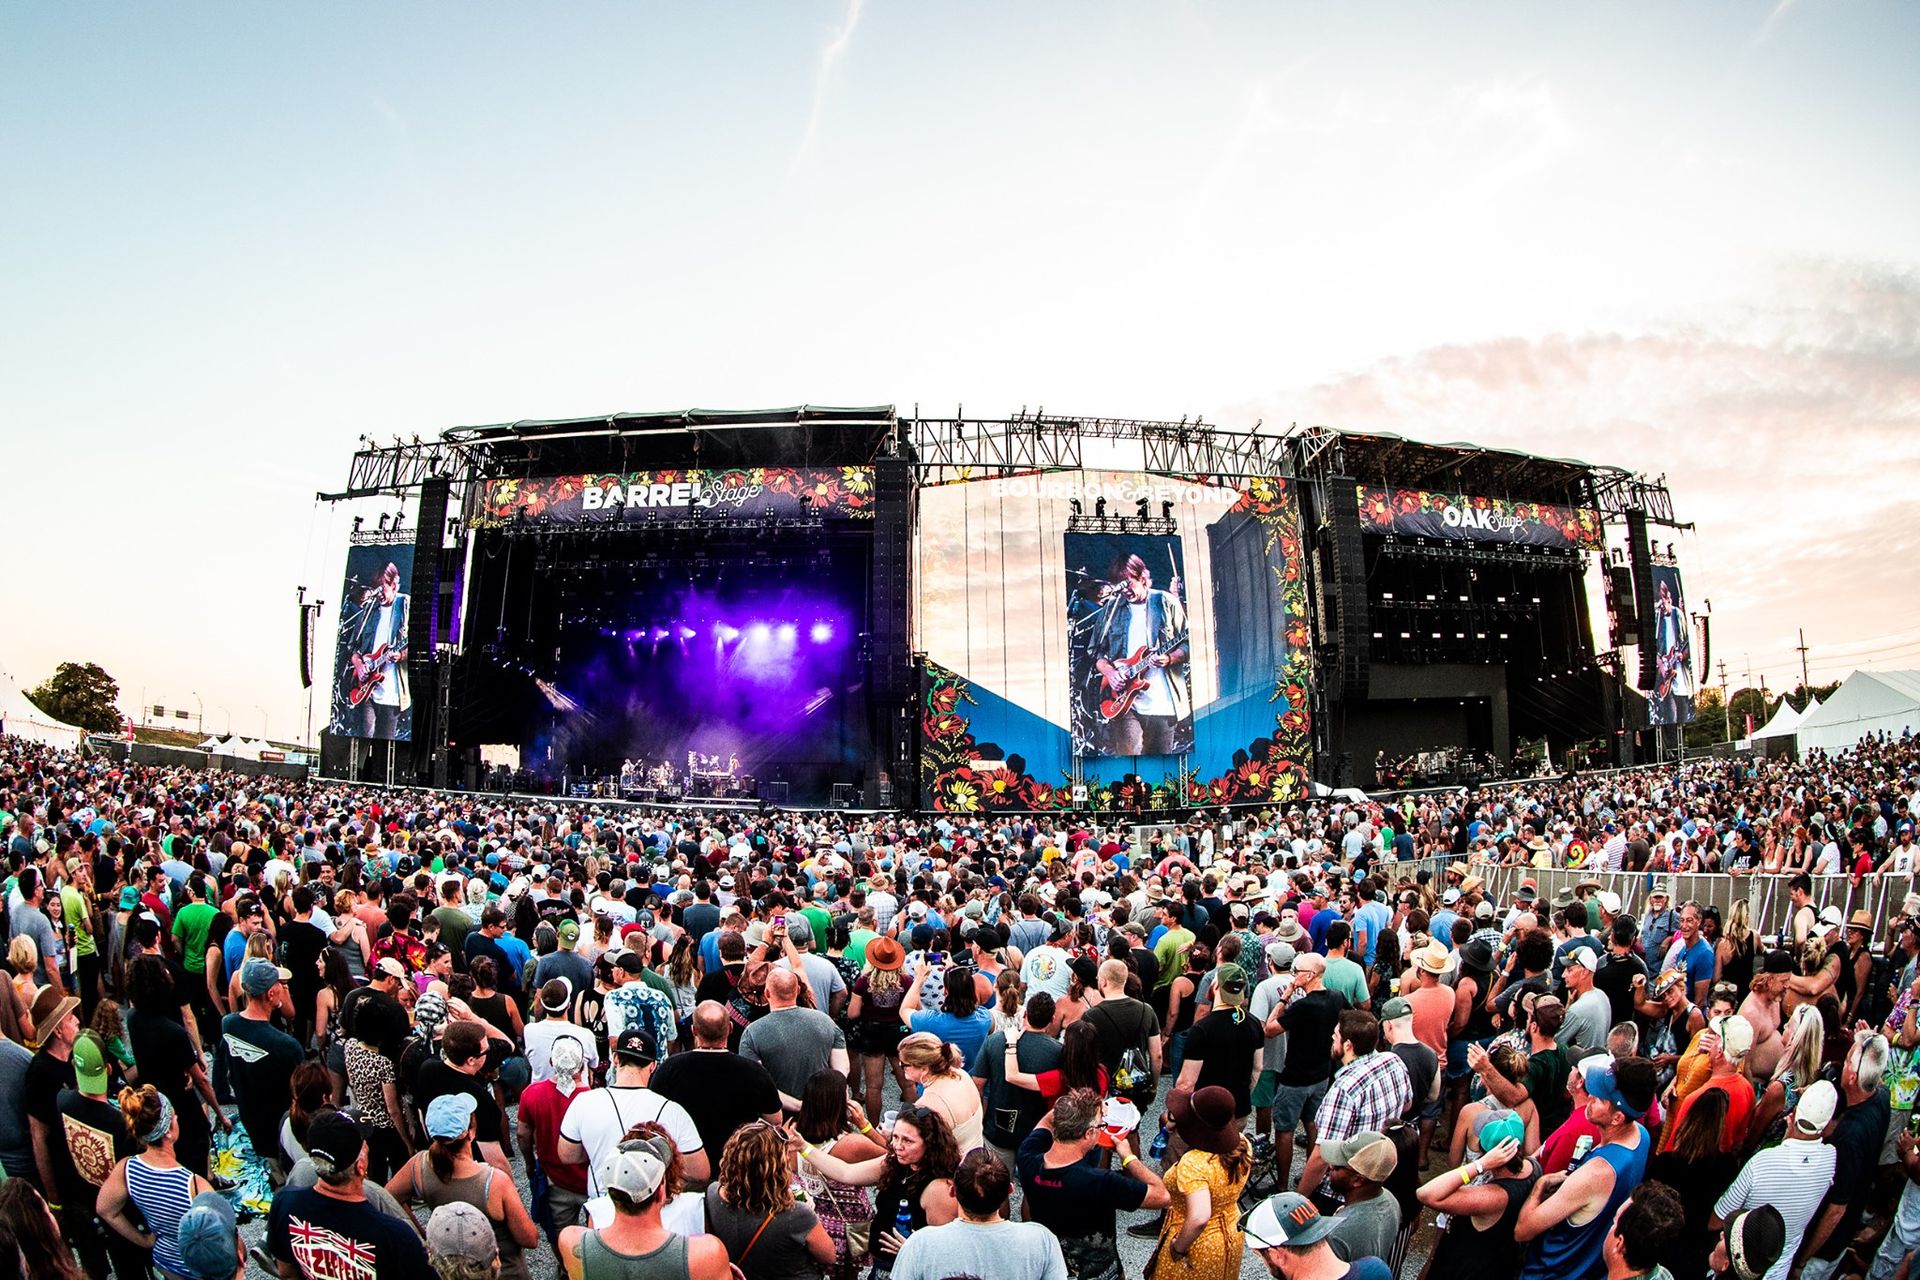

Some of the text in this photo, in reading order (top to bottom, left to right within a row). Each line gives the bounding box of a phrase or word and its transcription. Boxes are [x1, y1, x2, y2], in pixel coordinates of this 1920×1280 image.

[582, 480, 761, 509] BARREL Stage
[991, 479, 1237, 504] BOURBON & BEYOND
[1443, 505, 1523, 533] OAK Stage
